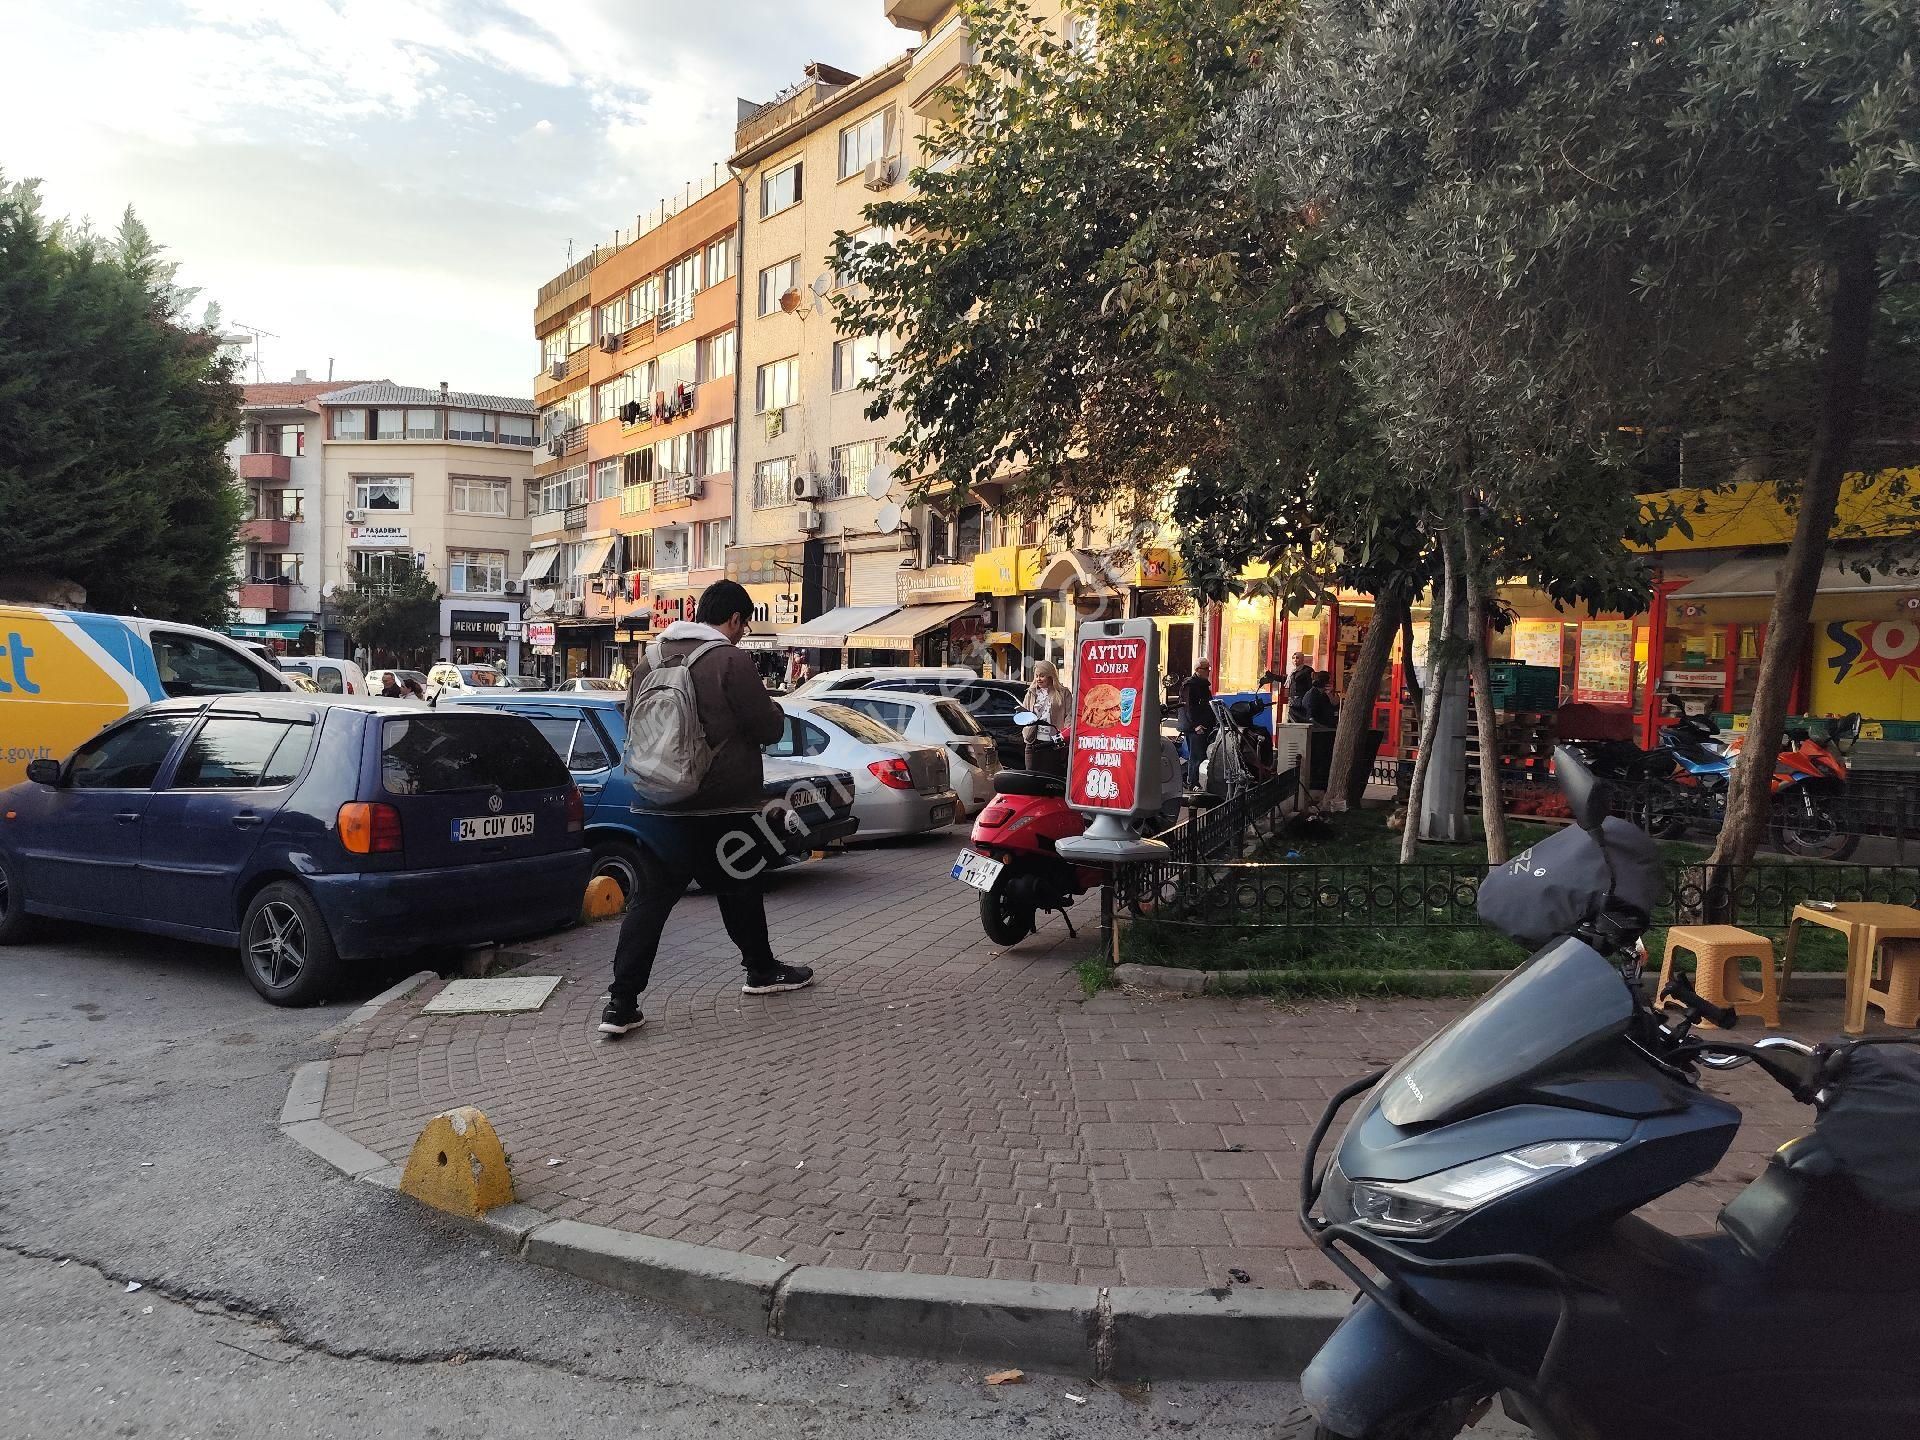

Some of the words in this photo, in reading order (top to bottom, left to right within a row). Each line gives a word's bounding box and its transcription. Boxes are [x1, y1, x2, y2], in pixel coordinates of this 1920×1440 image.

[365, 527, 402, 535] PAŞADENT
[453, 621, 482, 633] MERVE
[483, 622, 505, 634] MOD
[1087, 643, 1139, 661] AYTUN
[1095, 662, 1129, 675] DÖNER
[1078, 733, 1108, 751] TOMBİK
[1109, 734, 1136, 752] DÖNER
[0, 744, 52, 764] .gov.tr
[460, 820, 477, 839] 34
[483, 817, 507, 837] CUY
[511, 814, 533, 833] 045
[961, 852, 976, 866] 17
[964, 869, 987, 886] 1172
[1404, 1073, 1425, 1105] HONDA
